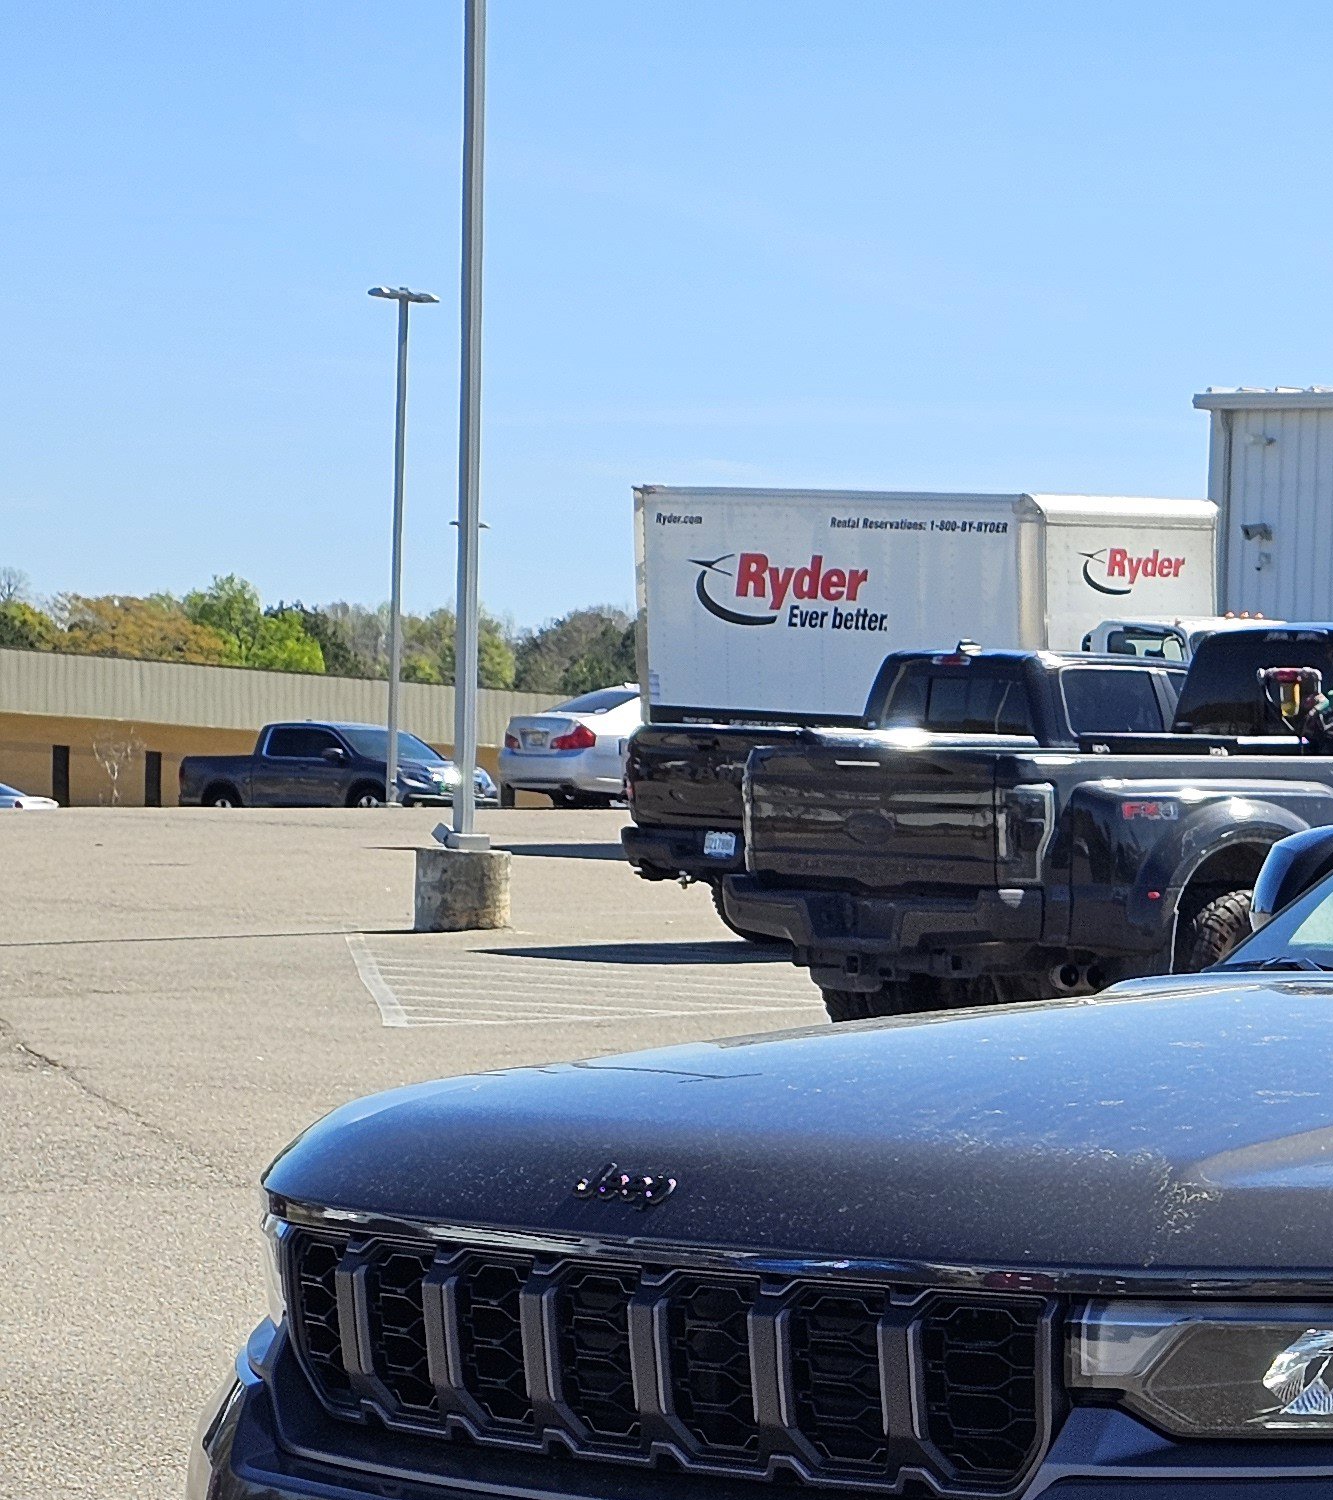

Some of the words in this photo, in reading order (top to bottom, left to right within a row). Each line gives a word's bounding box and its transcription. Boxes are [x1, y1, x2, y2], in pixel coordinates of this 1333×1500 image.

[656, 512, 703, 526] Ryder.com
[830, 516, 860, 530] Rental
[862, 517, 927, 531] Reservations:
[930, 520, 1009, 534] 1-800-BY-RYDER
[1107, 547, 1186, 585] Ryder
[735, 552, 869, 611] Ryder
[787, 604, 829, 628] Ever
[831, 606, 888, 631] better.
